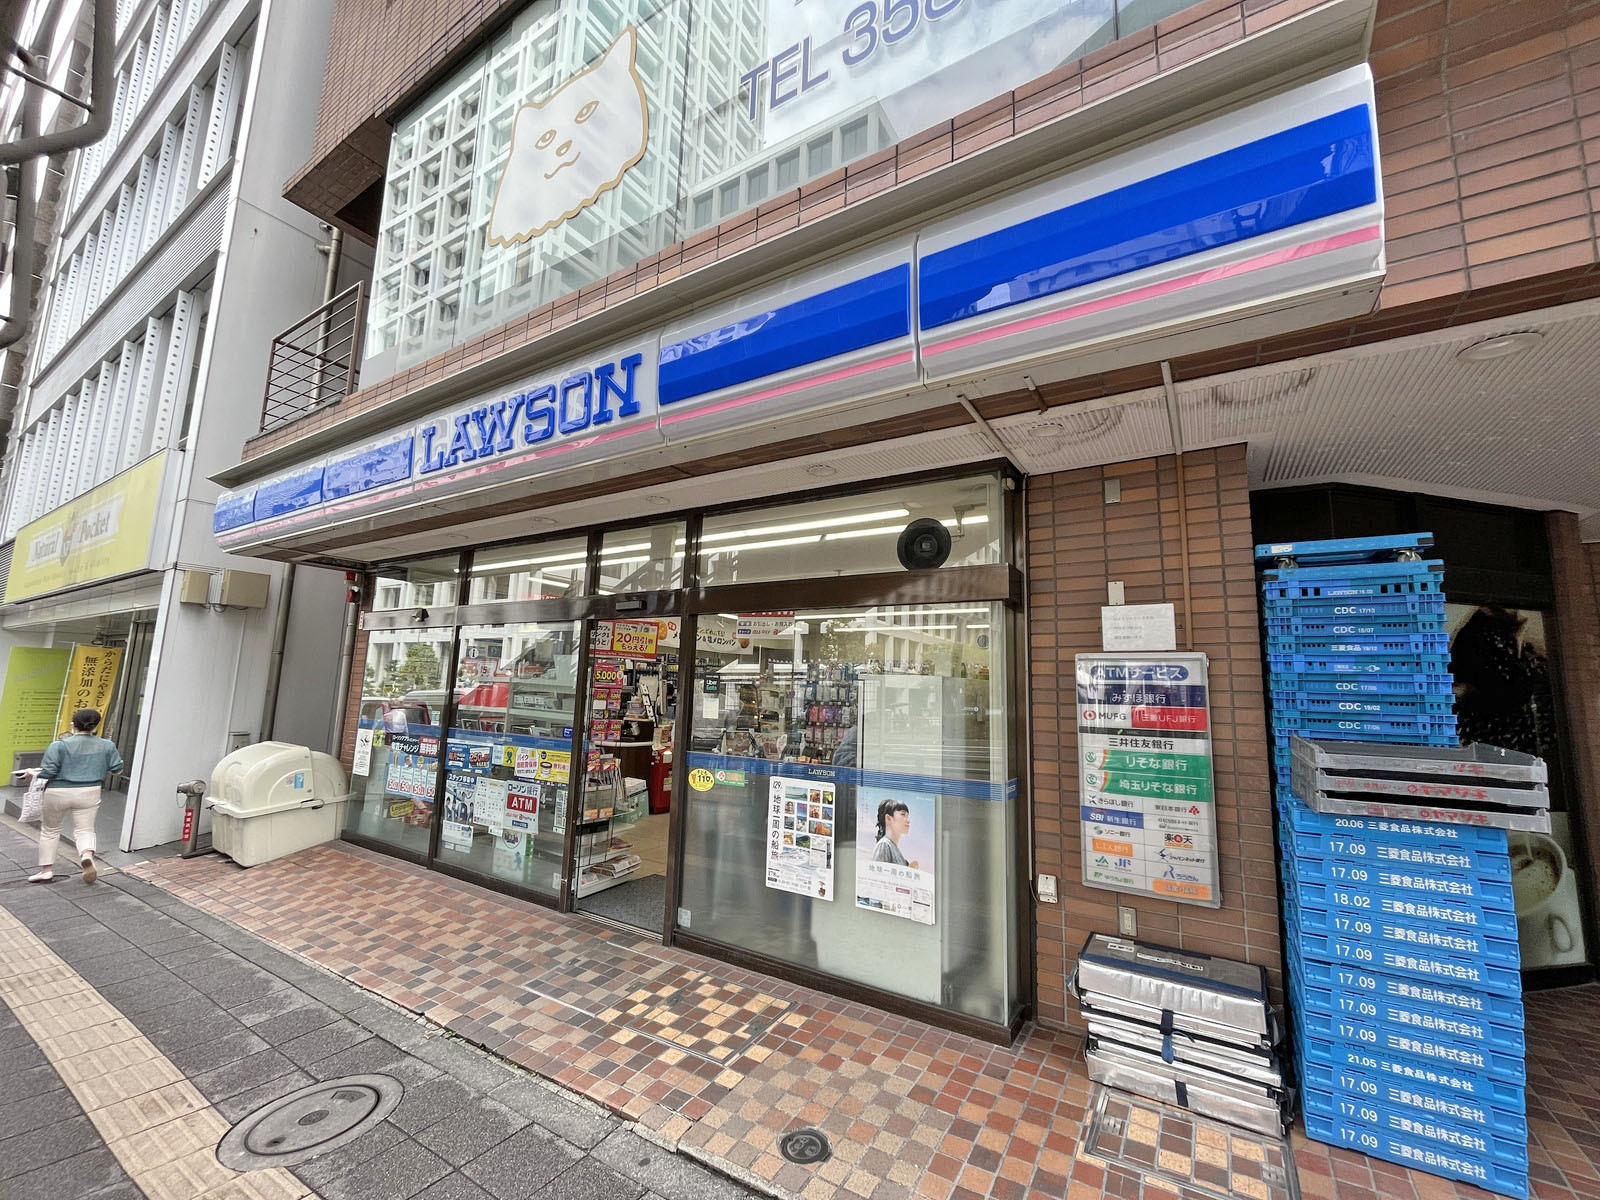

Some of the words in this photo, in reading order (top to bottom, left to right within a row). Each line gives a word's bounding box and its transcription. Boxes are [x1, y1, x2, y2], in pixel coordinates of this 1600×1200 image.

[741, 35, 829, 121] TEL
[420, 353, 642, 474] LAWSON
[79, 511, 111, 543] Pocket
[1334, 606, 1357, 614] CDC
[1333, 626, 1356, 634] CDC
[74, 656, 98, 712] 無添加のお
[96, 651, 116, 712] からだにやさし
[1096, 666, 1183, 679] ATMサービス
[1335, 682, 1358, 690] CDC
[1111, 692, 1166, 704] みずほ銀行
[1339, 702, 1361, 710] CDC
[1098, 712, 1127, 720] MUFG
[1141, 713, 1197, 724] 三菱UFJ銀行
[1338, 721, 1361, 729] CDC
[1109, 737, 1174, 750] 三井住友銀行
[808, 768, 836, 777] LAWSON
[1126, 756, 1188, 771] りそな銀行
[1120, 780, 1197, 795] 埼玉りそな銀行
[511, 797, 534, 811] ATM
[1090, 813, 1104, 821] SBI
[770, 795, 781, 861] 地球一周の船旅
[1335, 818, 1364, 829] 20.06
[1368, 821, 1458, 838] 三菱食品株式会社
[1330, 841, 1366, 855] 17.09
[1376, 846, 1471, 868] 三菱食品株式会社
[869, 864, 921, 881] 地球一周の船旅
[1331, 867, 1368, 881] 17.09
[1379, 872, 1474, 896] 三菱食品株式会社
[1334, 893, 1371, 908] 18.02
[1381, 899, 1478, 925] 三菱食品株式会社
[1335, 918, 1372, 934] 17.09
[1383, 925, 1479, 953] 三菱食品株式会社
[1336, 944, 1373, 961] 17.09
[1384, 953, 1480, 981] 三菱食品株式会社
[1339, 973, 1376, 989] 17.09
[1386, 981, 1483, 1011] 三菱食品株式会社
[1339, 999, 1376, 1015] 17.09
[1387, 1008, 1484, 1039] 三菱食品株式会社
[1339, 1025, 1376, 1042] 17.09
[1388, 1035, 1485, 1067] 三菱食品株式会社
[1347, 1054, 1377, 1068] 21.05
[1381, 1061, 1475, 1092] 三菱食品株式会社
[1340, 1076, 1377, 1095] 17.09
[1389, 1088, 1486, 1123] 三菱食品株式会社
[1340, 1103, 1378, 1122] 17.09
[1389, 1115, 1486, 1152] 三菱食品株式会社
[1341, 1128, 1378, 1148] 17.09
[1389, 1141, 1487, 1180] 三菱食品株式会社
